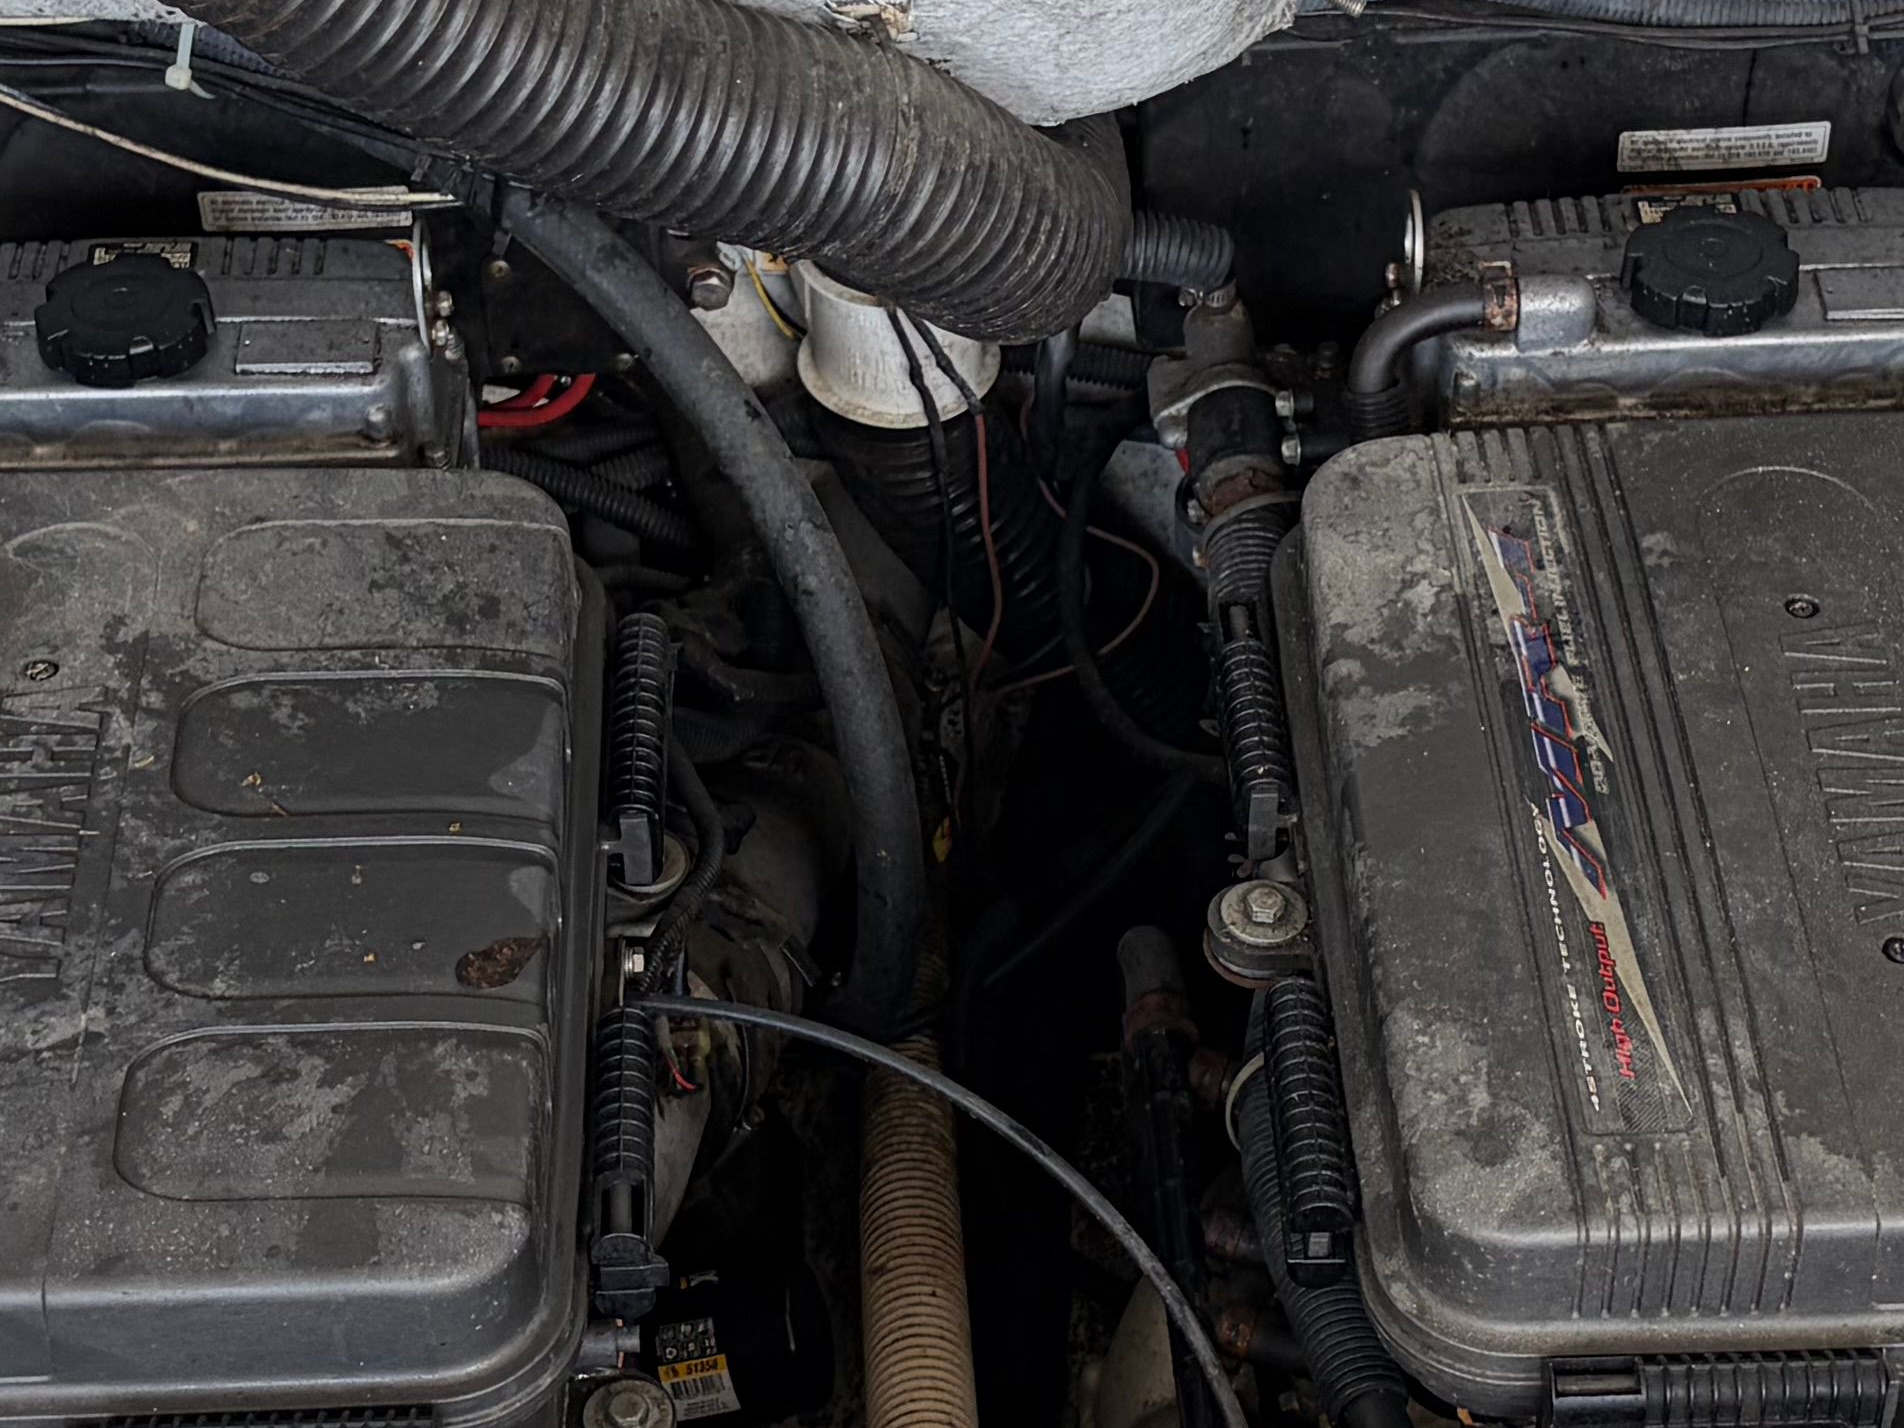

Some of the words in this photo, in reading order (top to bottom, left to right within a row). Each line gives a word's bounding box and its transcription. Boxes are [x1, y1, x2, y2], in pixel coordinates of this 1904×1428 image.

[1523, 794, 1571, 974] TECHNOLOGY
[1589, 921, 1622, 1015] Output
[1567, 983, 1599, 1112] 4STROKE
[1610, 1018, 1637, 1081] High
